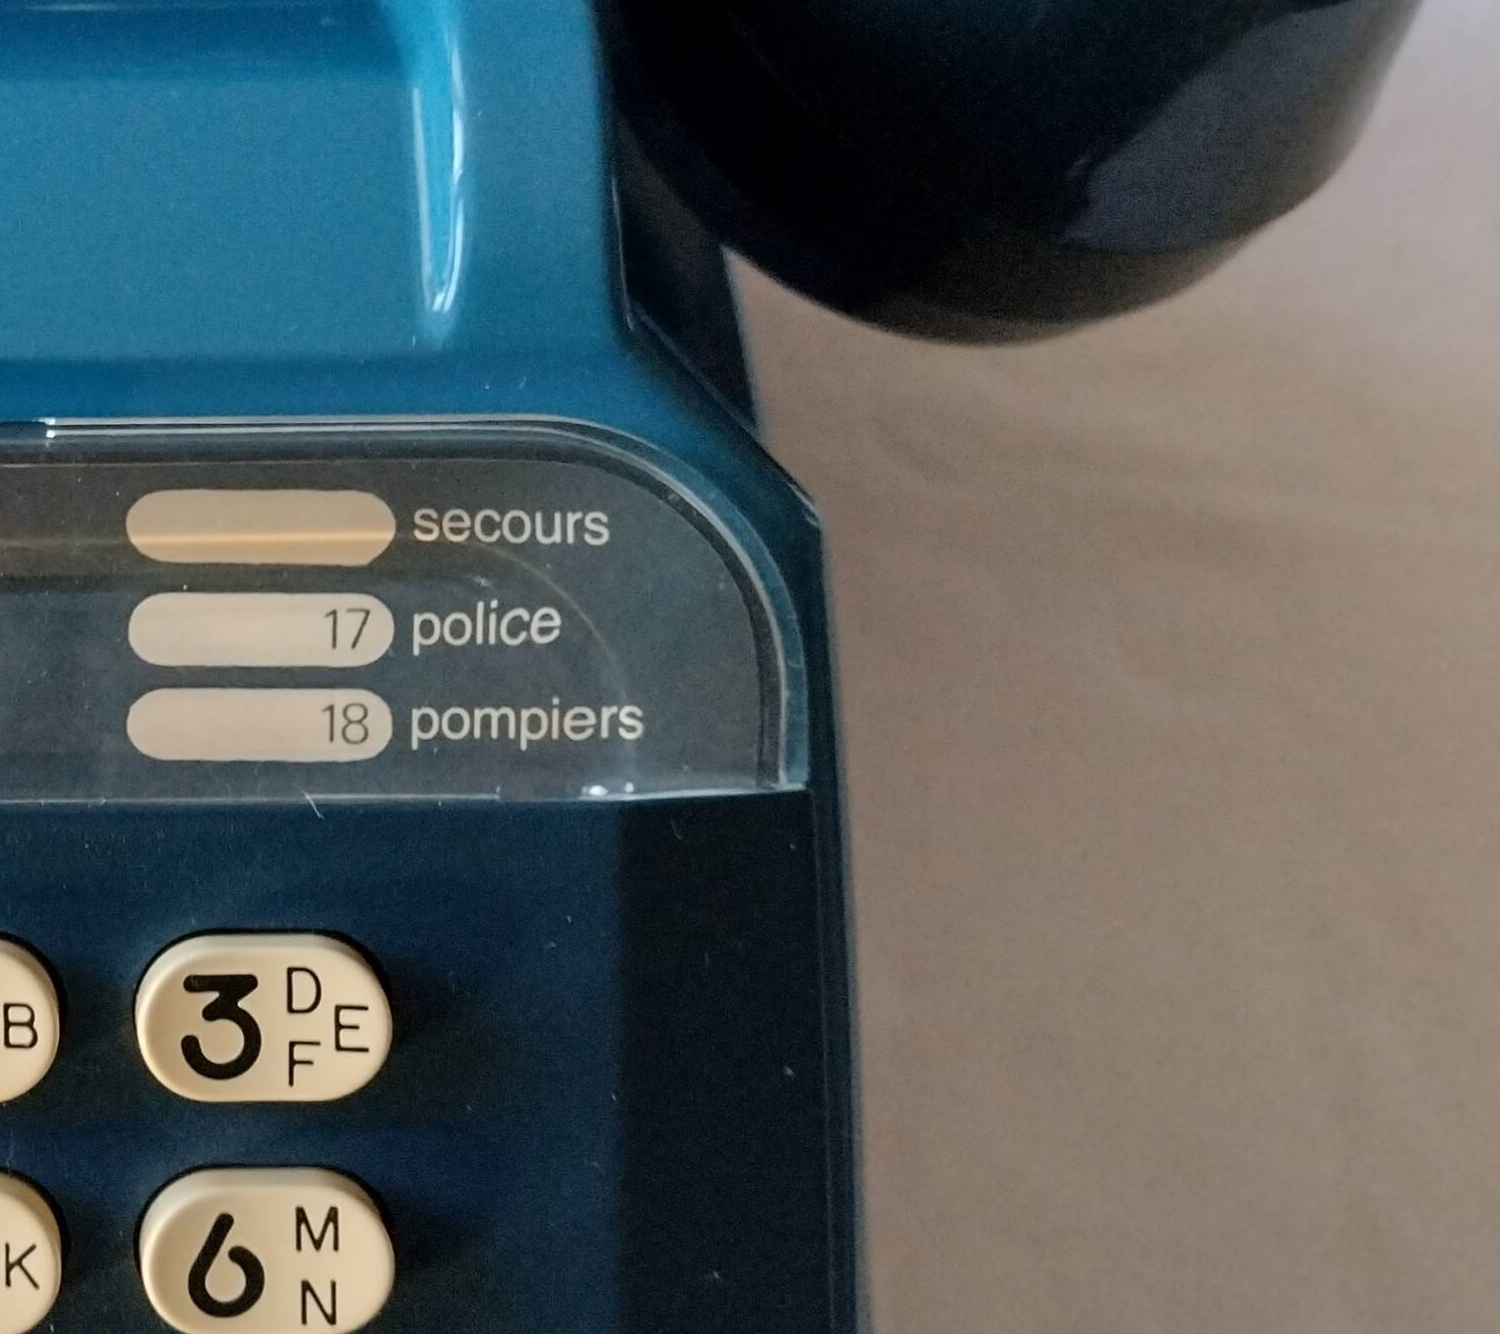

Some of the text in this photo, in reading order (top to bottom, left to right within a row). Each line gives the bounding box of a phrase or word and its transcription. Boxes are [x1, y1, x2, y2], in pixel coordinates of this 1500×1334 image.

[413, 508, 610, 546] secours
[323, 599, 562, 656] 17 police
[321, 697, 644, 751] 18 pompiers
[180, 973, 262, 1081] 3
[187, 1212, 265, 1319] 6
